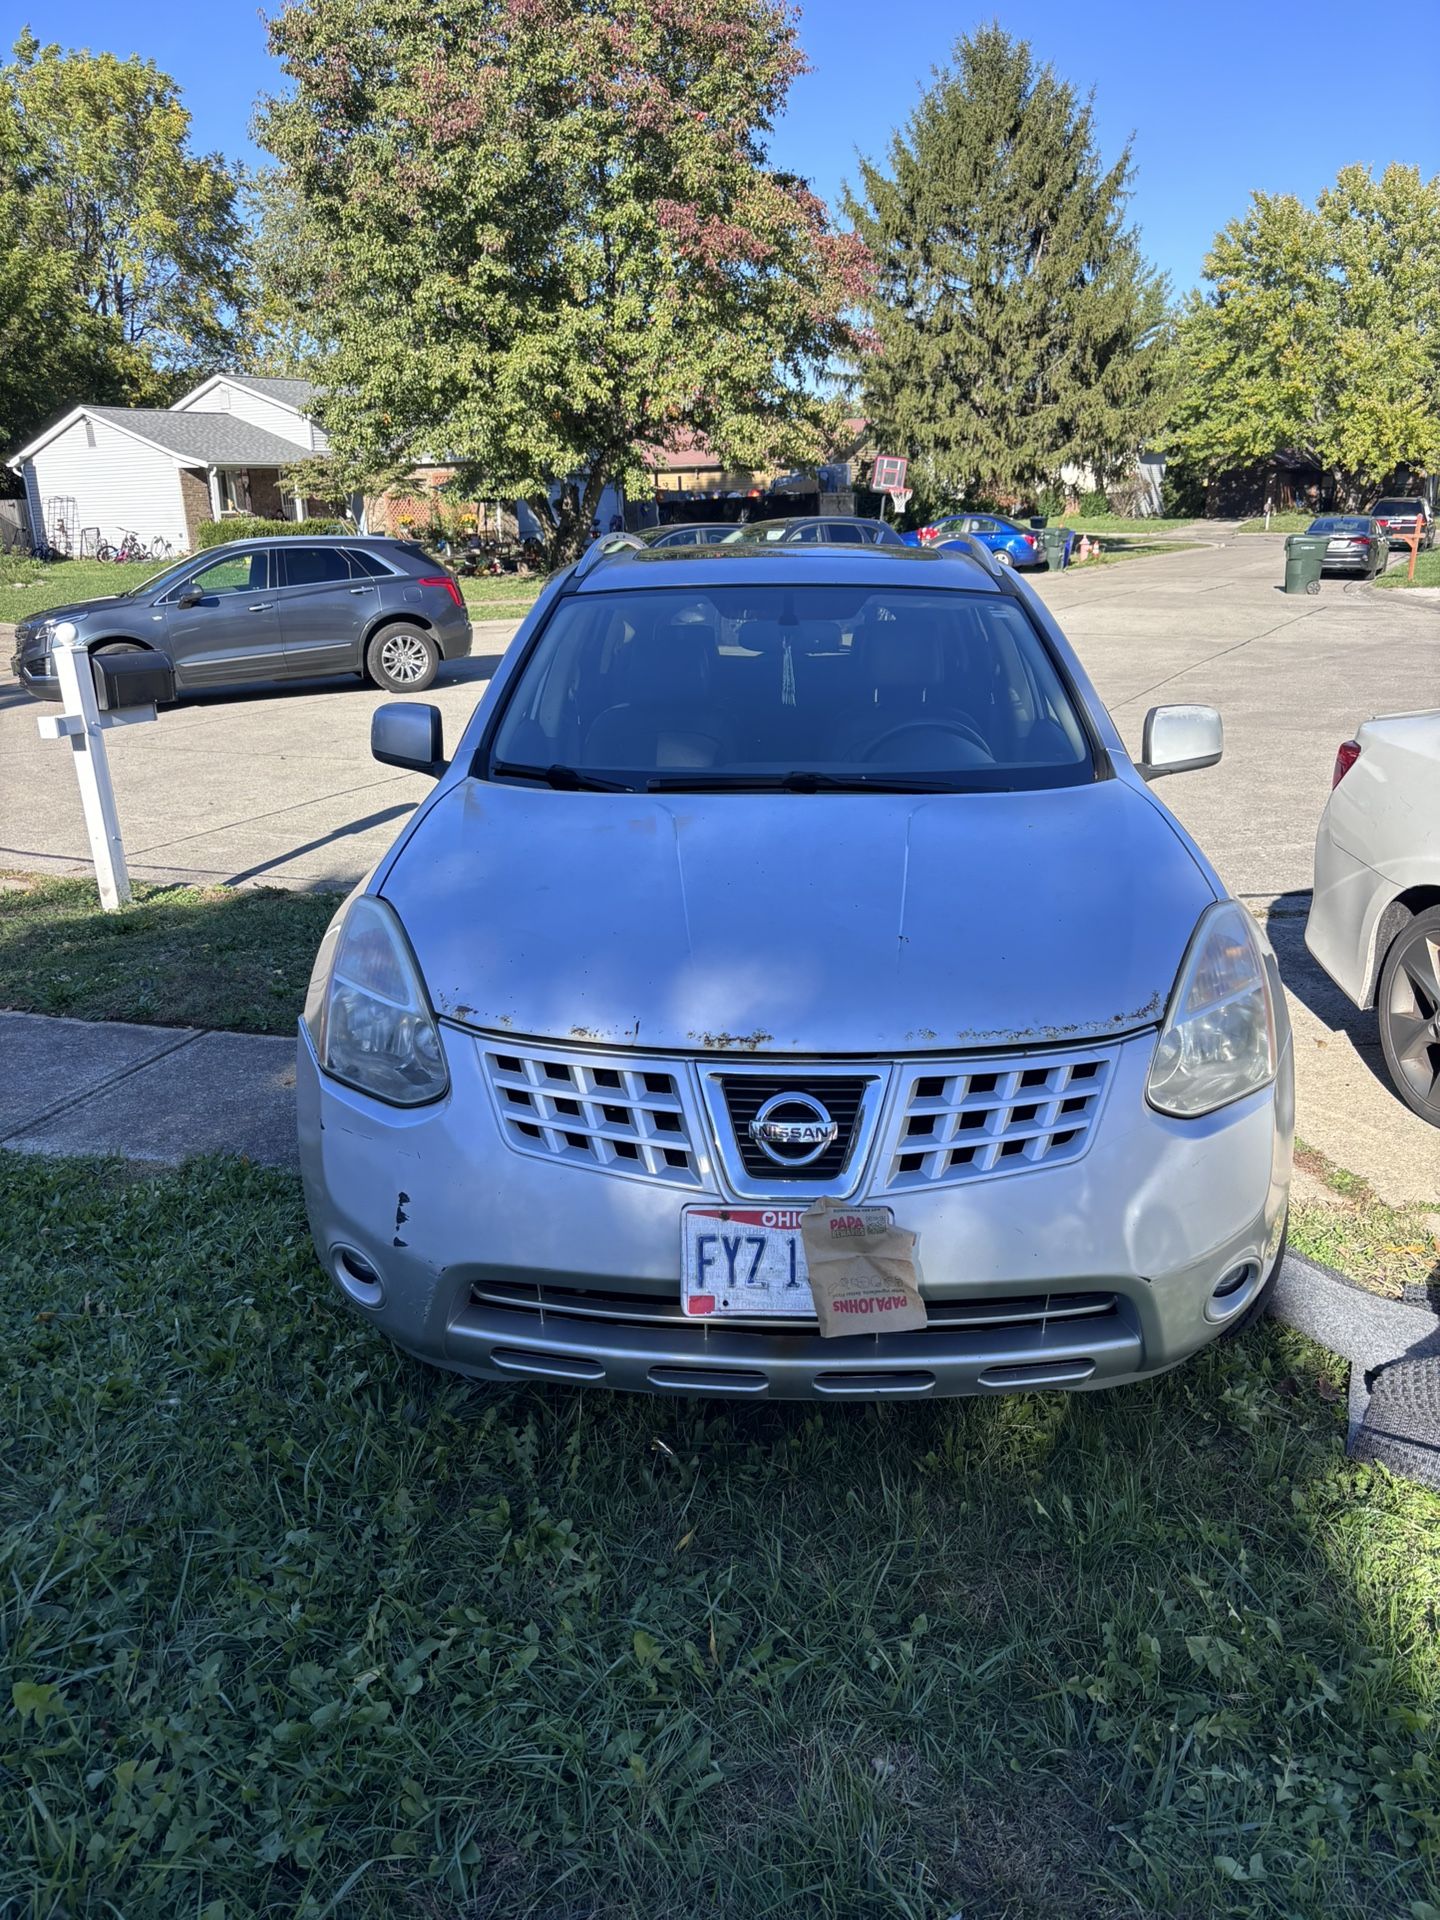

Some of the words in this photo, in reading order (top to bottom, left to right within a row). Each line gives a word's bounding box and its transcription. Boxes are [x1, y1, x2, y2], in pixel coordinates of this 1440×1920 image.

[758, 1125, 828, 1139] NISSAN
[830, 1215, 864, 1230] PAPA
[697, 1234, 768, 1289] FYZ
[832, 1297, 875, 1314] JOHNS
[876, 1295, 908, 1312] PAPA
